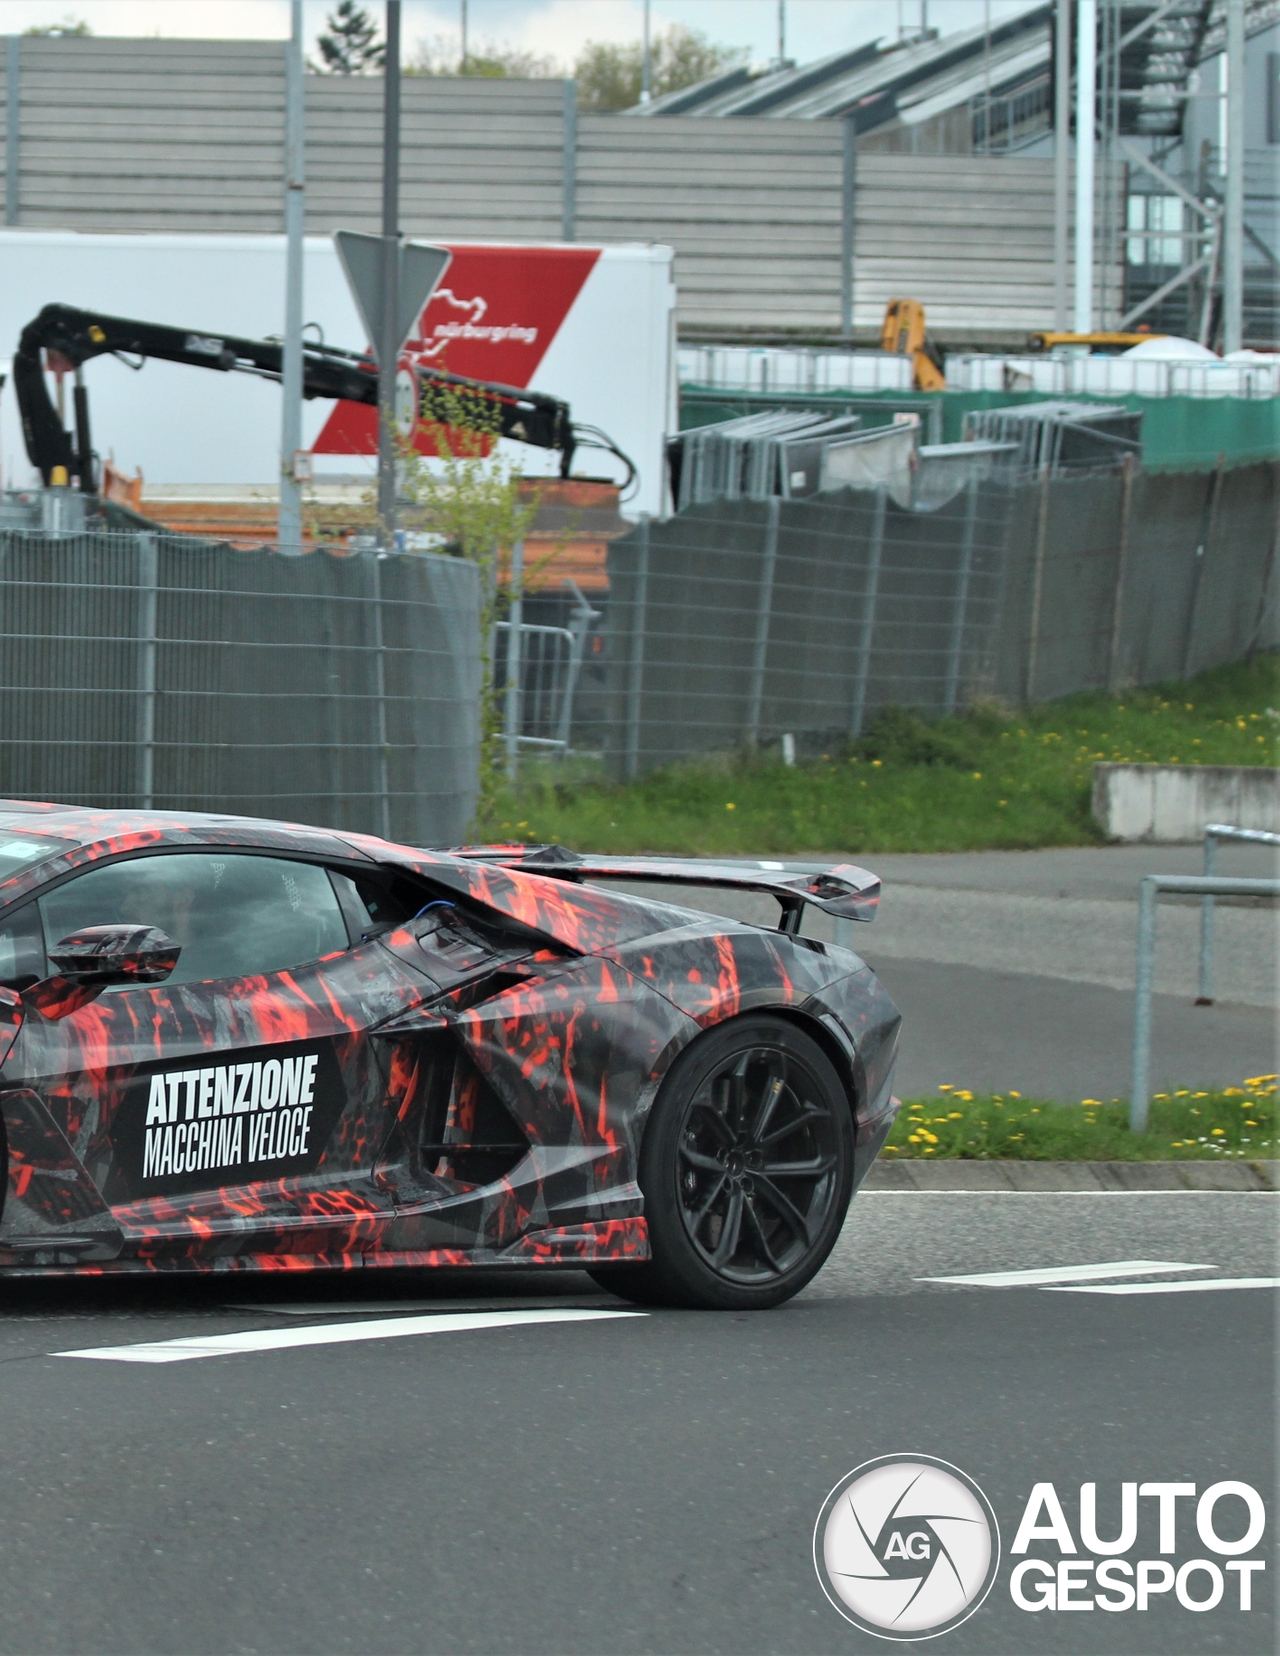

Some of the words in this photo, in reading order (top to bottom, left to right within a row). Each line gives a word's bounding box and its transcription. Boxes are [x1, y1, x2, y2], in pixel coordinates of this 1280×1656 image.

[433, 321, 539, 345] nürburgring
[145, 1054, 319, 1126] ATTENZIONE
[142, 1116, 243, 1178] MACCHINA
[248, 1105, 314, 1163] VELOCE
